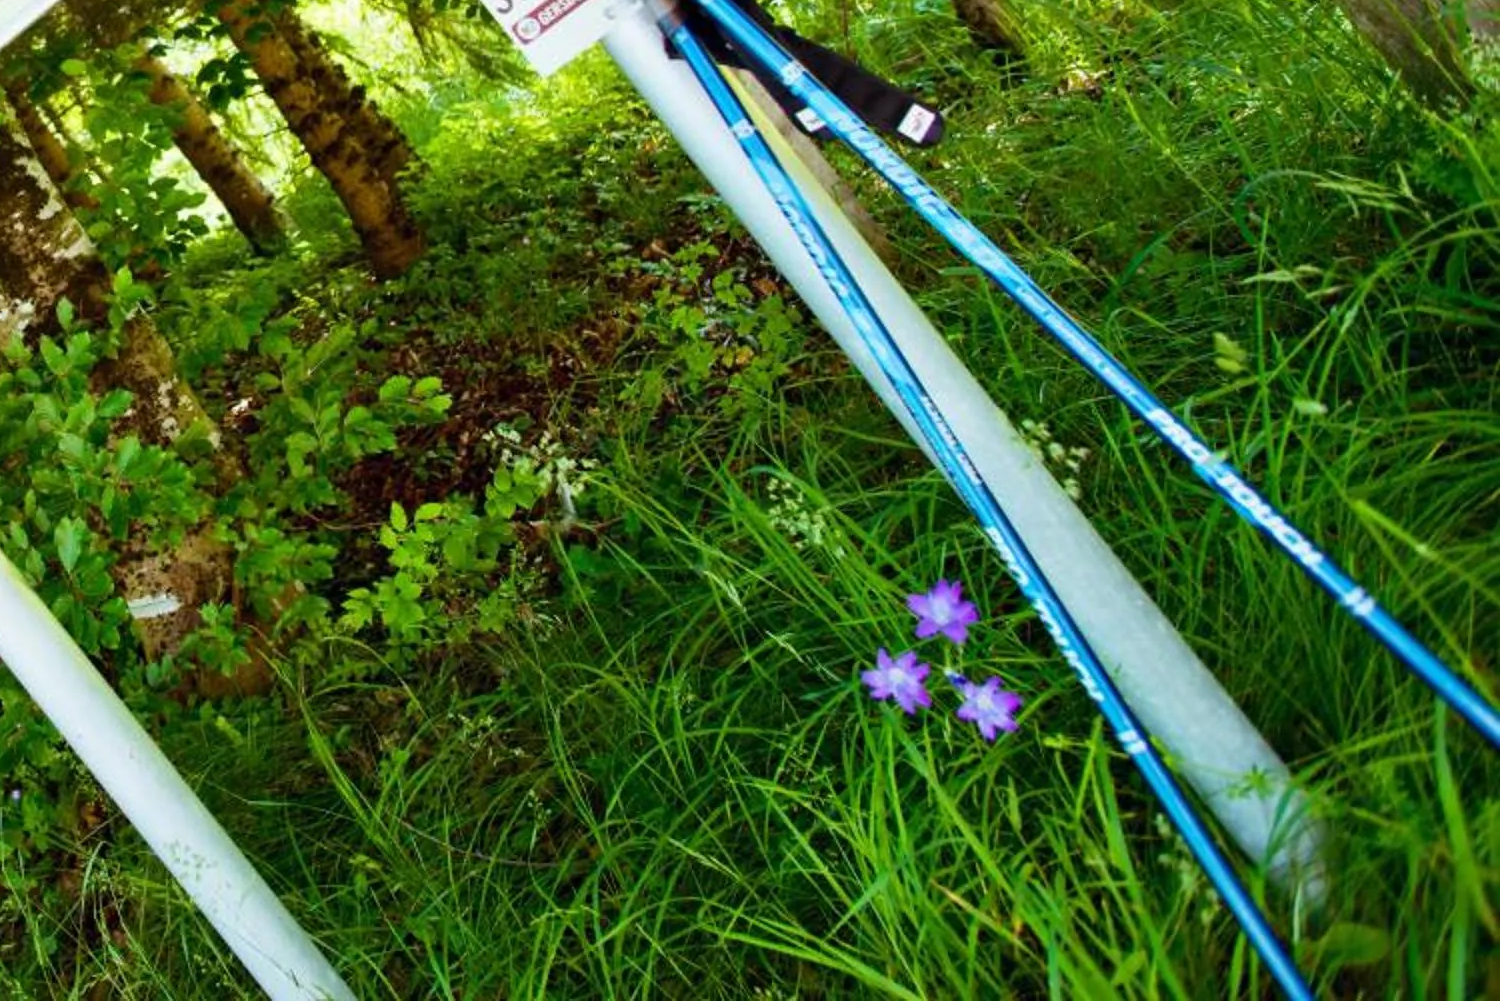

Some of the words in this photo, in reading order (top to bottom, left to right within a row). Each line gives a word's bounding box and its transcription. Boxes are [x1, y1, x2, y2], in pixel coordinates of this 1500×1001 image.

[829, 111, 950, 221] NORDIC
[1144, 404, 1209, 465] PRO
[1214, 468, 1326, 572] TOUCH
